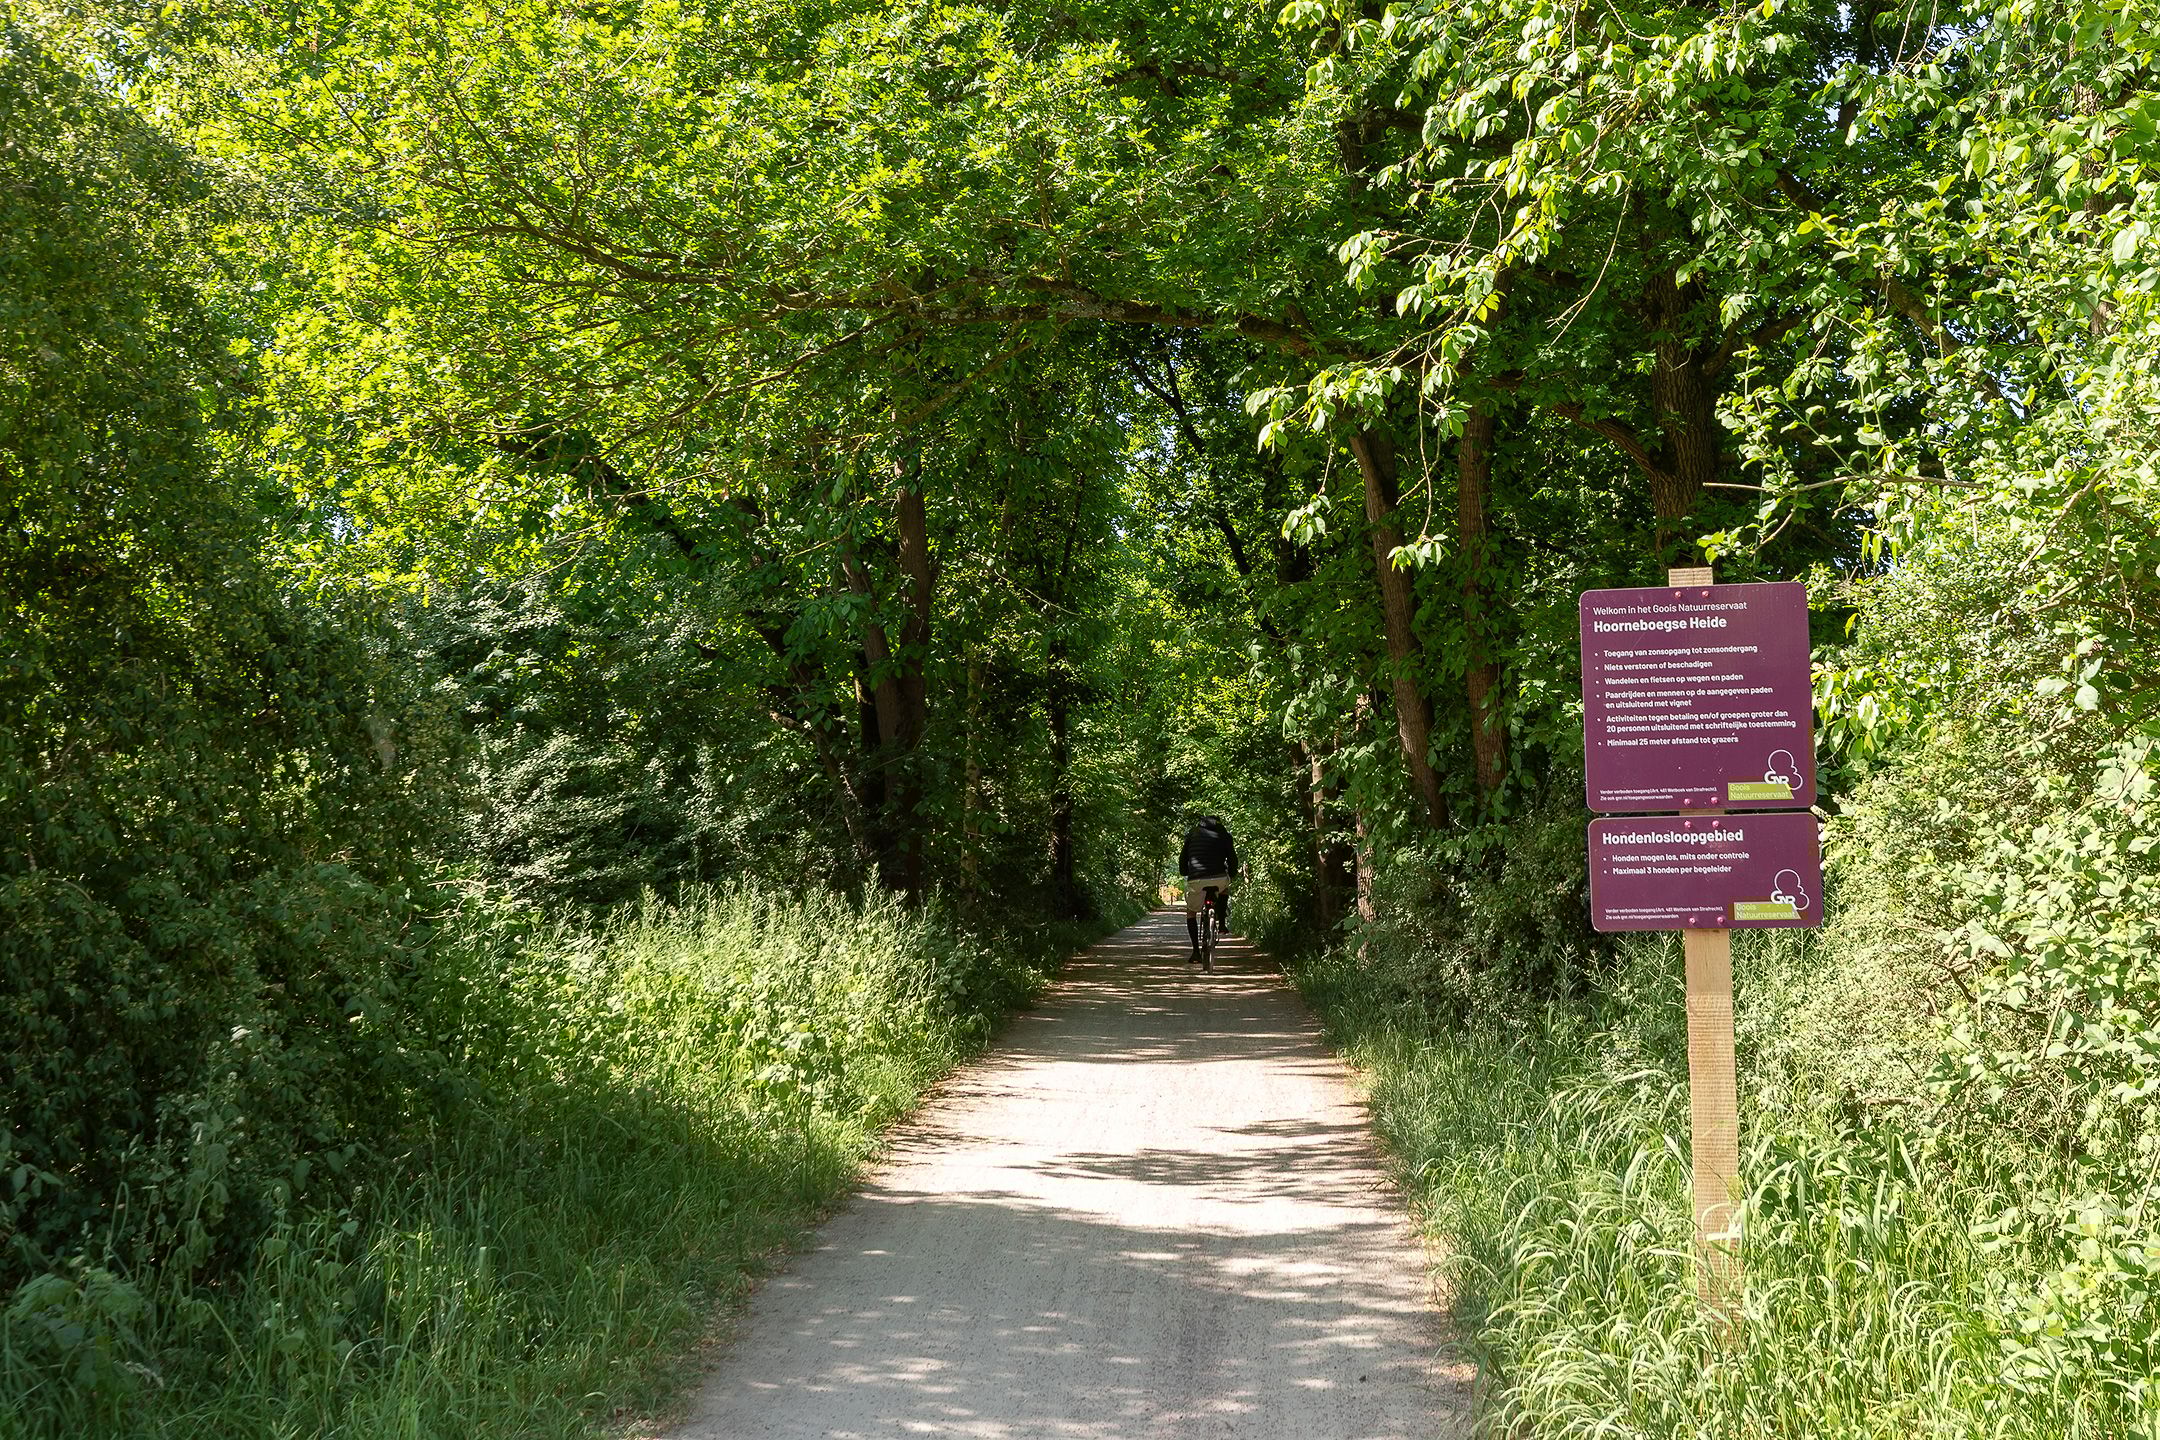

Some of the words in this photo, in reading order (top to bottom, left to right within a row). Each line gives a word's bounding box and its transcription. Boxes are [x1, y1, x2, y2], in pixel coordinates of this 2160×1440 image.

[1593, 606, 1626, 616] Welkom
[1628, 606, 1636, 614] in
[1638, 605, 1651, 614] het
[1653, 604, 1677, 613] Goois
[1678, 602, 1747, 612] Natuurreservaat
[1594, 619, 1687, 632] Hoorneboegse
[1690, 616, 1727, 628] Heide
[1604, 650, 1634, 658] Toegang
[1648, 647, 1690, 656] zonsopgang
[1704, 646, 1758, 654] zonsondergang
[1668, 661, 1712, 669] beschadigen
[1721, 674, 1744, 682] paden
[1605, 691, 1646, 699] Paardrijden
[1706, 688, 1750, 696] aangegeven
[1750, 686, 1773, 694] paden
[1616, 700, 1653, 708] uitsluitend
[1669, 699, 1692, 707] vignet
[1606, 714, 1647, 722] Activiteiten
[1648, 714, 1669, 722] tegen
[1670, 713, 1699, 721] betaling
[1700, 712, 1718, 720] en/of
[1720, 712, 1750, 720] groepen
[1751, 711, 1773, 719] groter
[1606, 725, 1616, 733] 20
[1651, 723, 1688, 731] uitsluitend
[1705, 721, 1747, 730] schriftelijke
[1748, 720, 1796, 728] toestemming
[1712, 736, 1738, 744] grazers
[1764, 770, 1791, 787] GNR
[1602, 829, 1743, 845] Hondenlosloopgebied
[1719, 852, 1750, 860] controle
[1612, 867, 1646, 875] Maximaal
[1652, 866, 1679, 874] honden
[1693, 865, 1731, 874] begeleider
[1771, 890, 1798, 907] GNR
